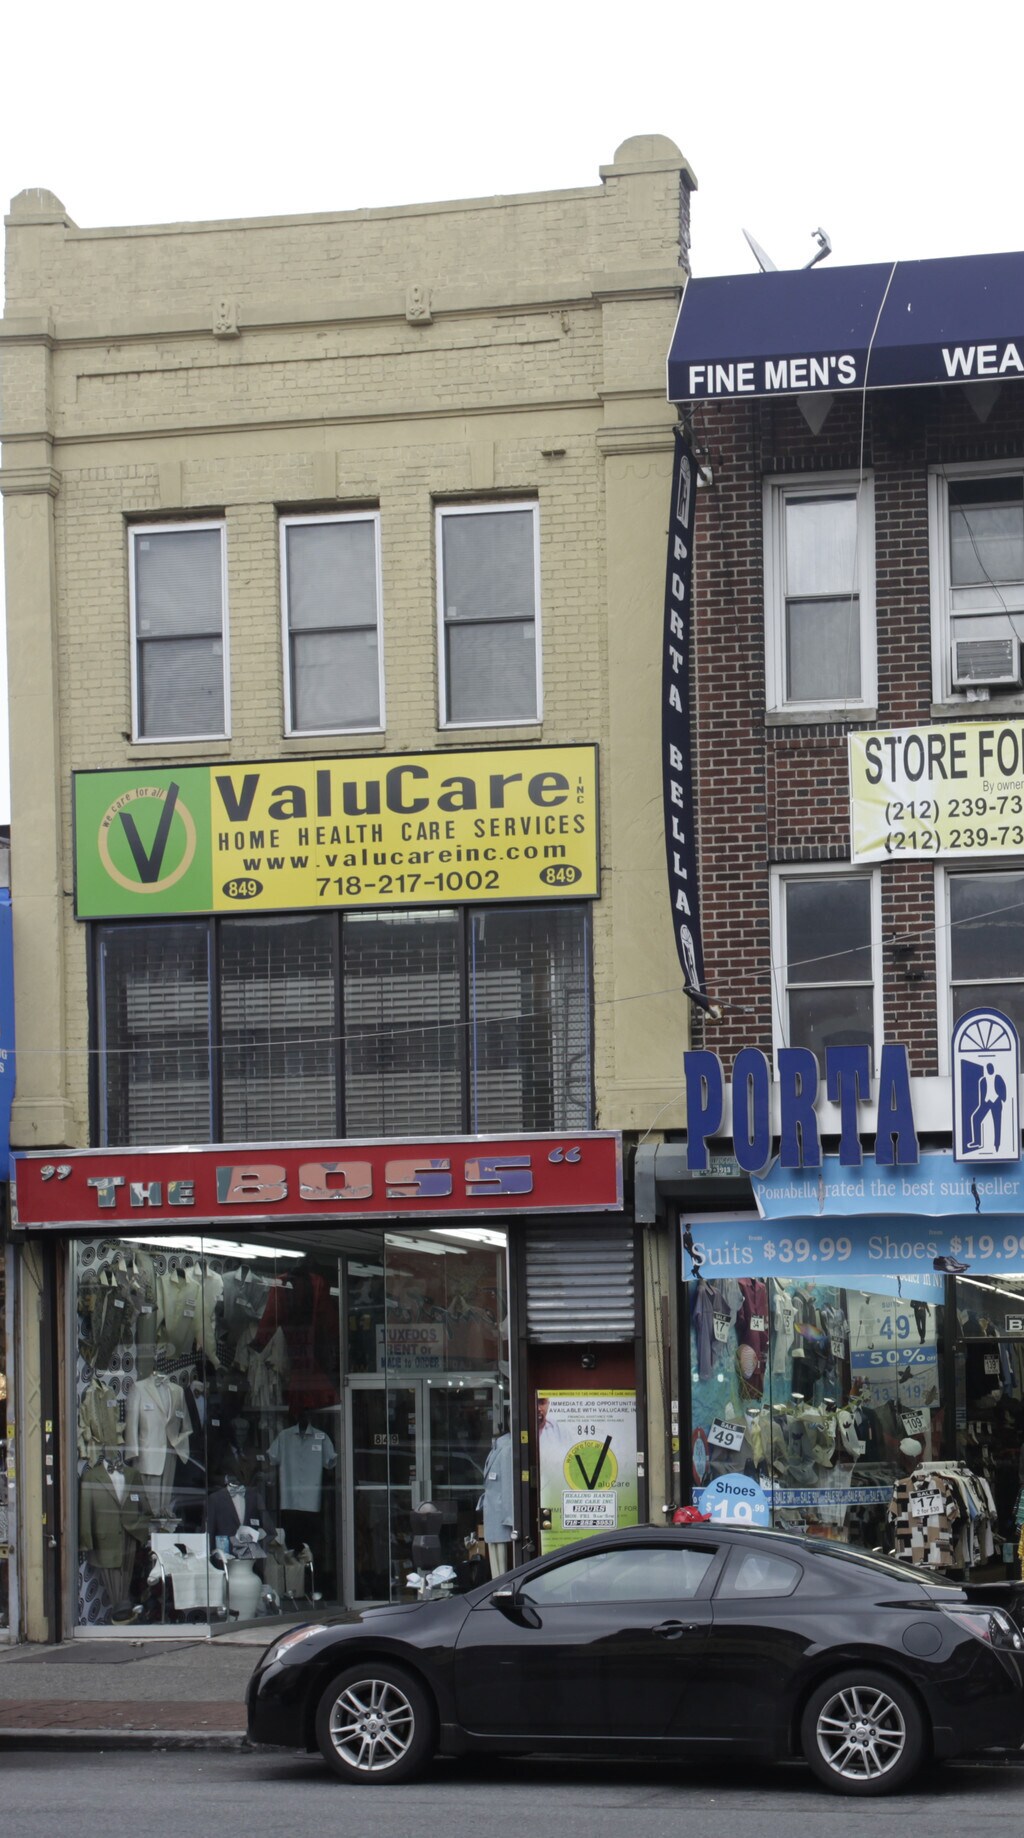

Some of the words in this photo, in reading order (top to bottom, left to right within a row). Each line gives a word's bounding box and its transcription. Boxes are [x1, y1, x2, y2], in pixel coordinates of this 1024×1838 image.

[689, 361, 755, 394] FINE
[764, 355, 857, 387] MEN'S
[669, 534, 688, 714] PORTA
[865, 732, 968, 784] STORE
[215, 764, 570, 822] ValuCare
[982, 780, 995, 793] By
[997, 779, 1024, 791] owner
[102, 815, 113, 829] we
[111, 792, 131, 813] care
[136, 787, 149, 798] for
[151, 787, 165, 798] all
[885, 799, 940, 825] (212)
[219, 829, 280, 851] HOME
[299, 823, 383, 846] HEALTH
[401, 820, 455, 842] CARE
[475, 814, 586, 838] SERVICES
[669, 743, 691, 917] BELLA
[885, 830, 942, 854] (212)
[243, 844, 567, 871] www.valucareinc.com
[229, 880, 257, 897] 849
[316, 869, 501, 897] 718-217-1002
[546, 867, 576, 884] 849
[683, 1043, 921, 1172] PORTA
[216, 1154, 535, 1204] BOSS
[825, 1179, 865, 1198] rated
[871, 1178, 896, 1197] the
[902, 1178, 935, 1196] best
[940, 1178, 972, 1196] suit
[978, 1177, 1020, 1195] seller
[692, 1241, 753, 1267] Suits
[763, 1237, 852, 1264] $39.99
[868, 1233, 939, 1260] Shoes
[381, 1328, 437, 1340] TUXEDOS
[870, 1349, 926, 1365] 50%
[577, 1425, 596, 1436] 849
[720, 1422, 737, 1431] SALE
[716, 1481, 756, 1497] Shoes
